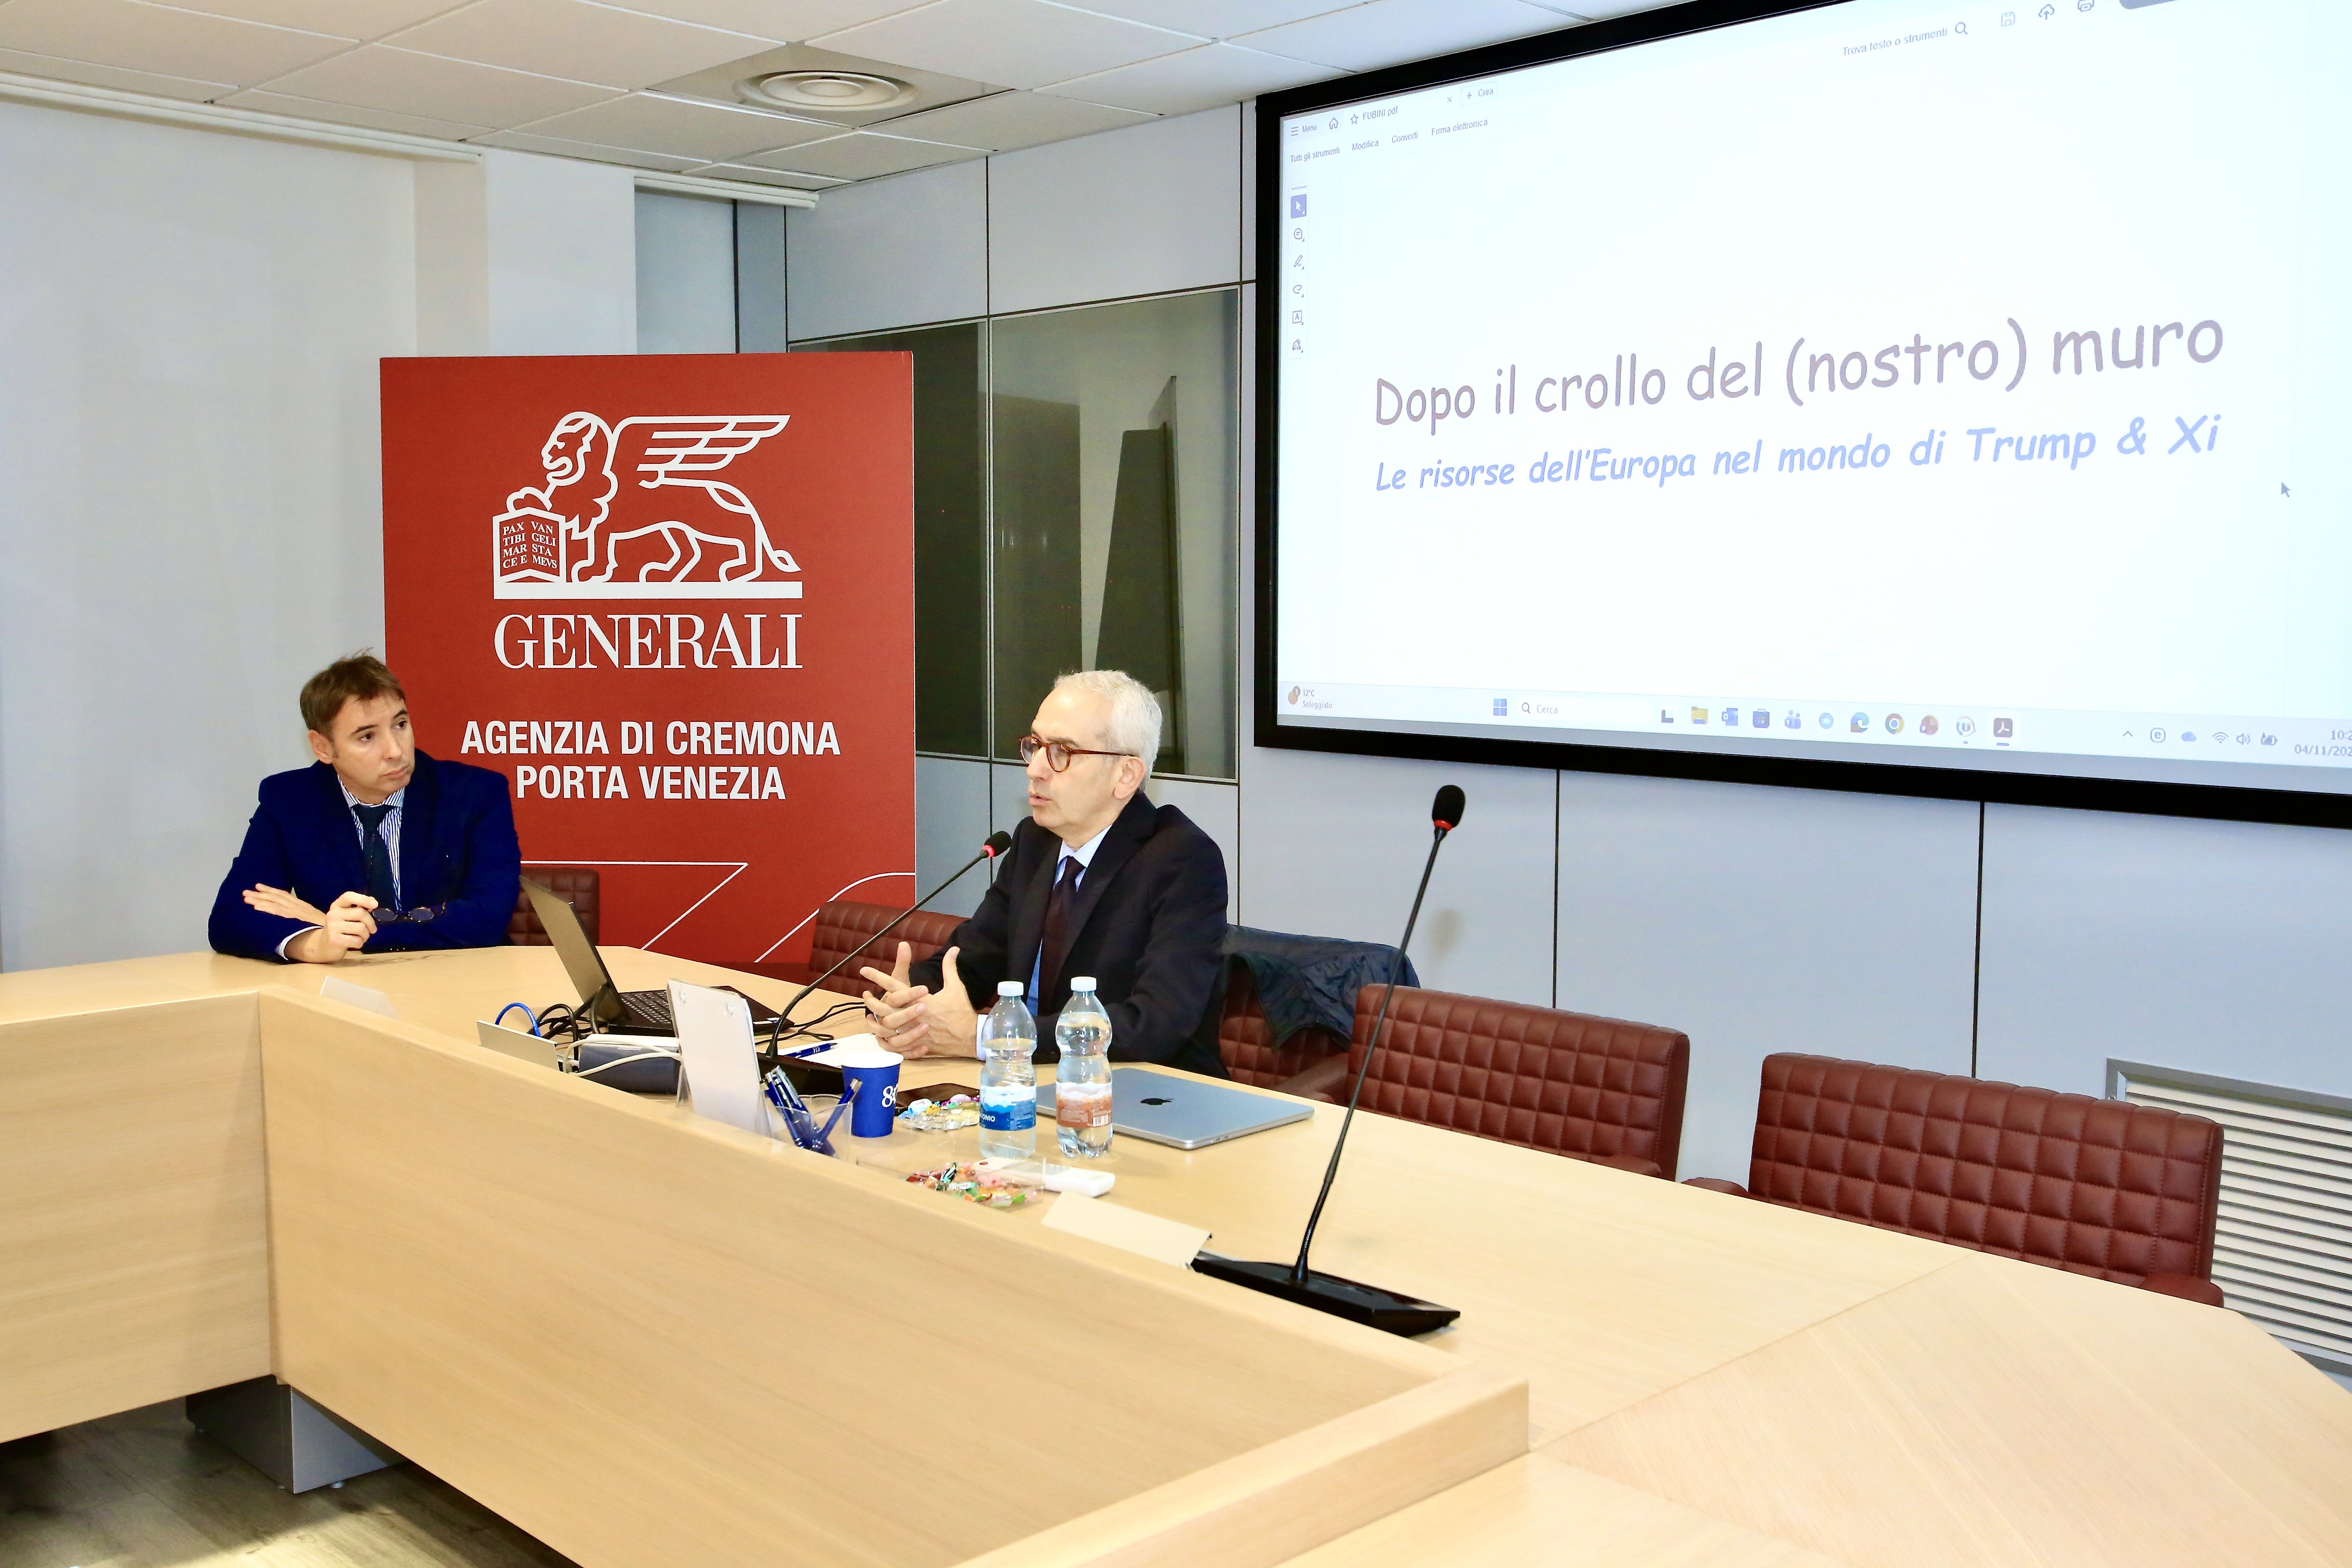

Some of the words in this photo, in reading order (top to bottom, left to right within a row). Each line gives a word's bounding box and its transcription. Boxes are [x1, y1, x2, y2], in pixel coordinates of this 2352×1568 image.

[1842, 45, 1866, 56] Trova
[1869, 39, 1892, 51] testo
[1904, 27, 1947, 43] strumenti
[1478, 88, 1494, 97] Crea
[1363, 106, 1398, 120] FUBINI.pdf
[1302, 125, 1317, 133] Menu
[1431, 126, 1450, 136] Firma
[1452, 119, 1488, 131] elettronica
[1392, 132, 1418, 143] Converti
[1312, 147, 1340, 158] strumenti
[1352, 140, 1379, 151] Modifica
[1376, 379, 1475, 436] Dopo
[1496, 364, 1516, 414] il
[1535, 353, 1666, 413] crollo
[1687, 341, 1762, 401] del
[1786, 318, 2027, 407] (nostro)
[2053, 320, 2223, 376] muro
[1376, 462, 1406, 491] Le
[1420, 459, 1515, 488] risorse
[1529, 448, 1696, 488] dell'Europa
[1713, 439, 1762, 475] nel
[1778, 433, 1890, 473] mondo
[1909, 429, 1946, 466] di
[1967, 428, 2096, 471] Trump
[2117, 416, 2147, 455] &
[2168, 414, 2221, 455] Xi
[503, 522, 524, 535] PAX
[531, 521, 553, 535] VAN
[503, 532, 526, 546] TIBI
[531, 532, 556, 546] GELI
[503, 544, 527, 558] MAR
[532, 543, 552, 557] STA
[503, 557, 518, 568] CE
[520, 555, 527, 564] E
[532, 555, 557, 569] MEVS
[494, 613, 803, 669] GENERALI
[1303, 701, 1332, 710] Soleggiato
[1537, 705, 1558, 715] Cerca
[461, 720, 610, 755] AGENZIA
[621, 721, 653, 755] DI
[666, 720, 841, 756] CREMONA
[517, 765, 629, 799] PORTA
[638, 766, 786, 800] VENEZIA
[882, 1083, 898, 1108] 8
